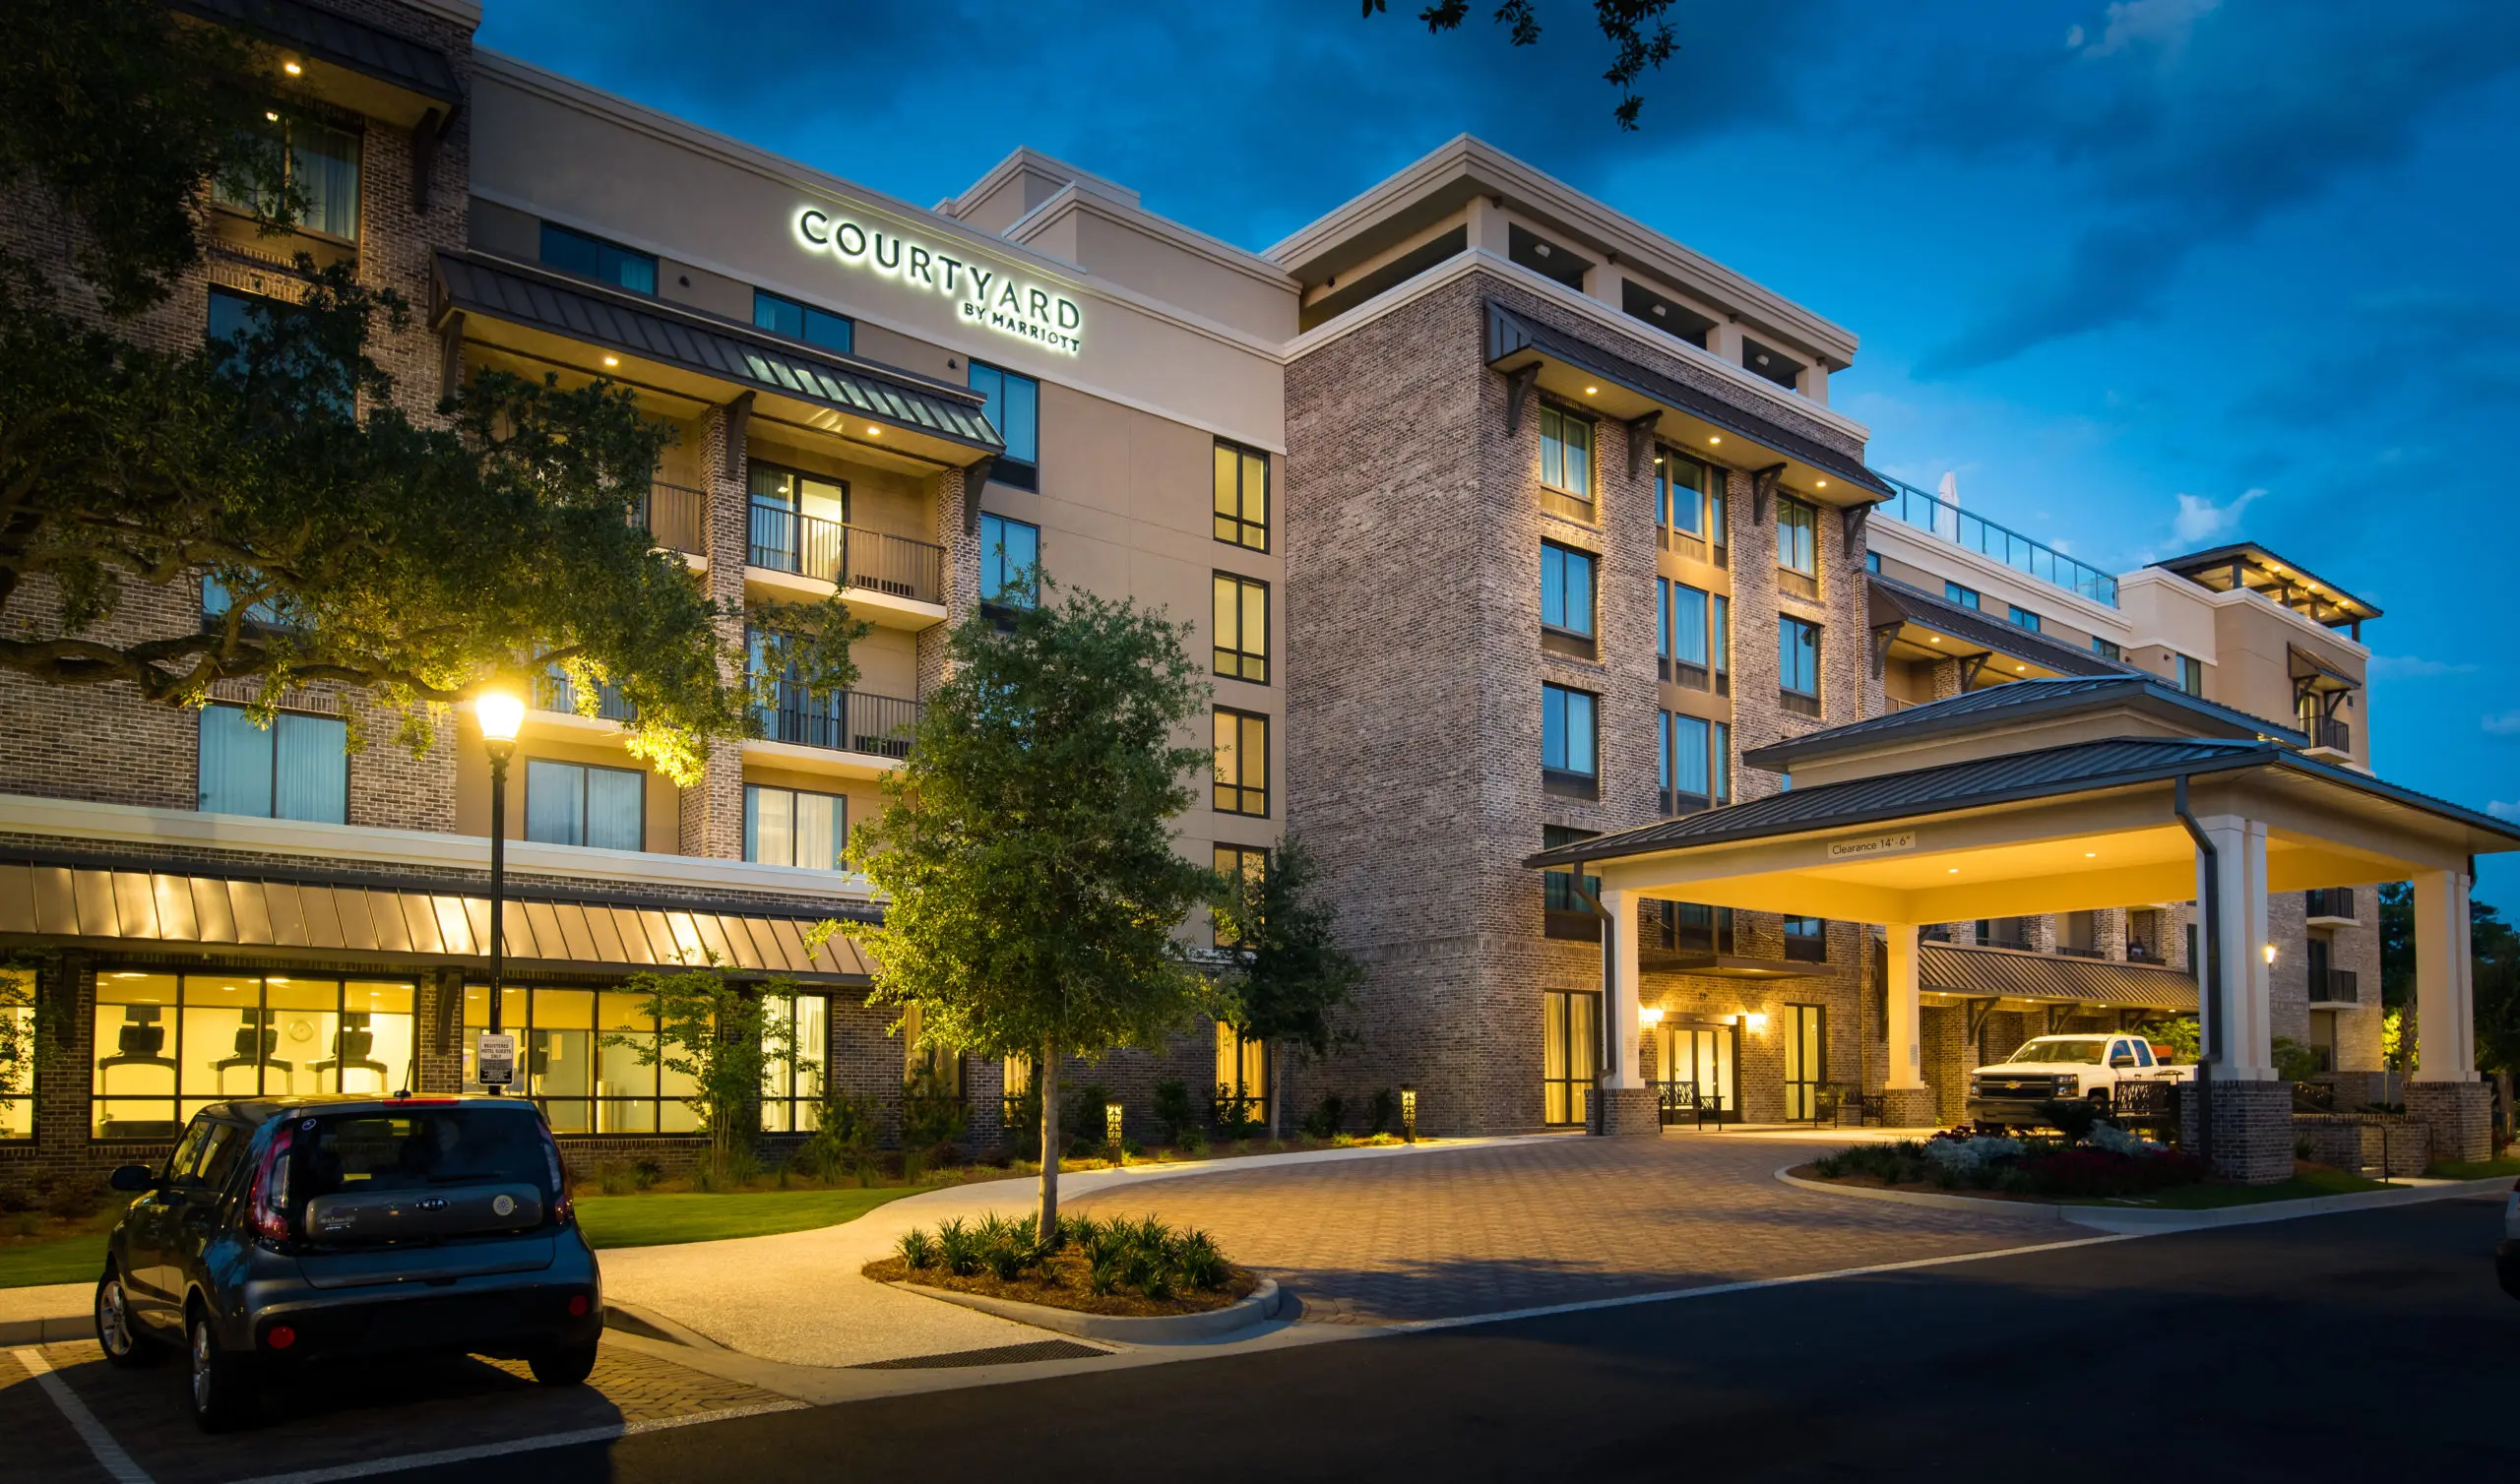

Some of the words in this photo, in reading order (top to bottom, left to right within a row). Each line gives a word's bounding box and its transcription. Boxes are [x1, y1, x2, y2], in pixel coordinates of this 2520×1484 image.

[798, 209, 1081, 330] COURTYARD
[964, 301, 985, 320] BY
[991, 312, 1081, 352] MARRIOTT
[1832, 841, 1877, 855] Clearance
